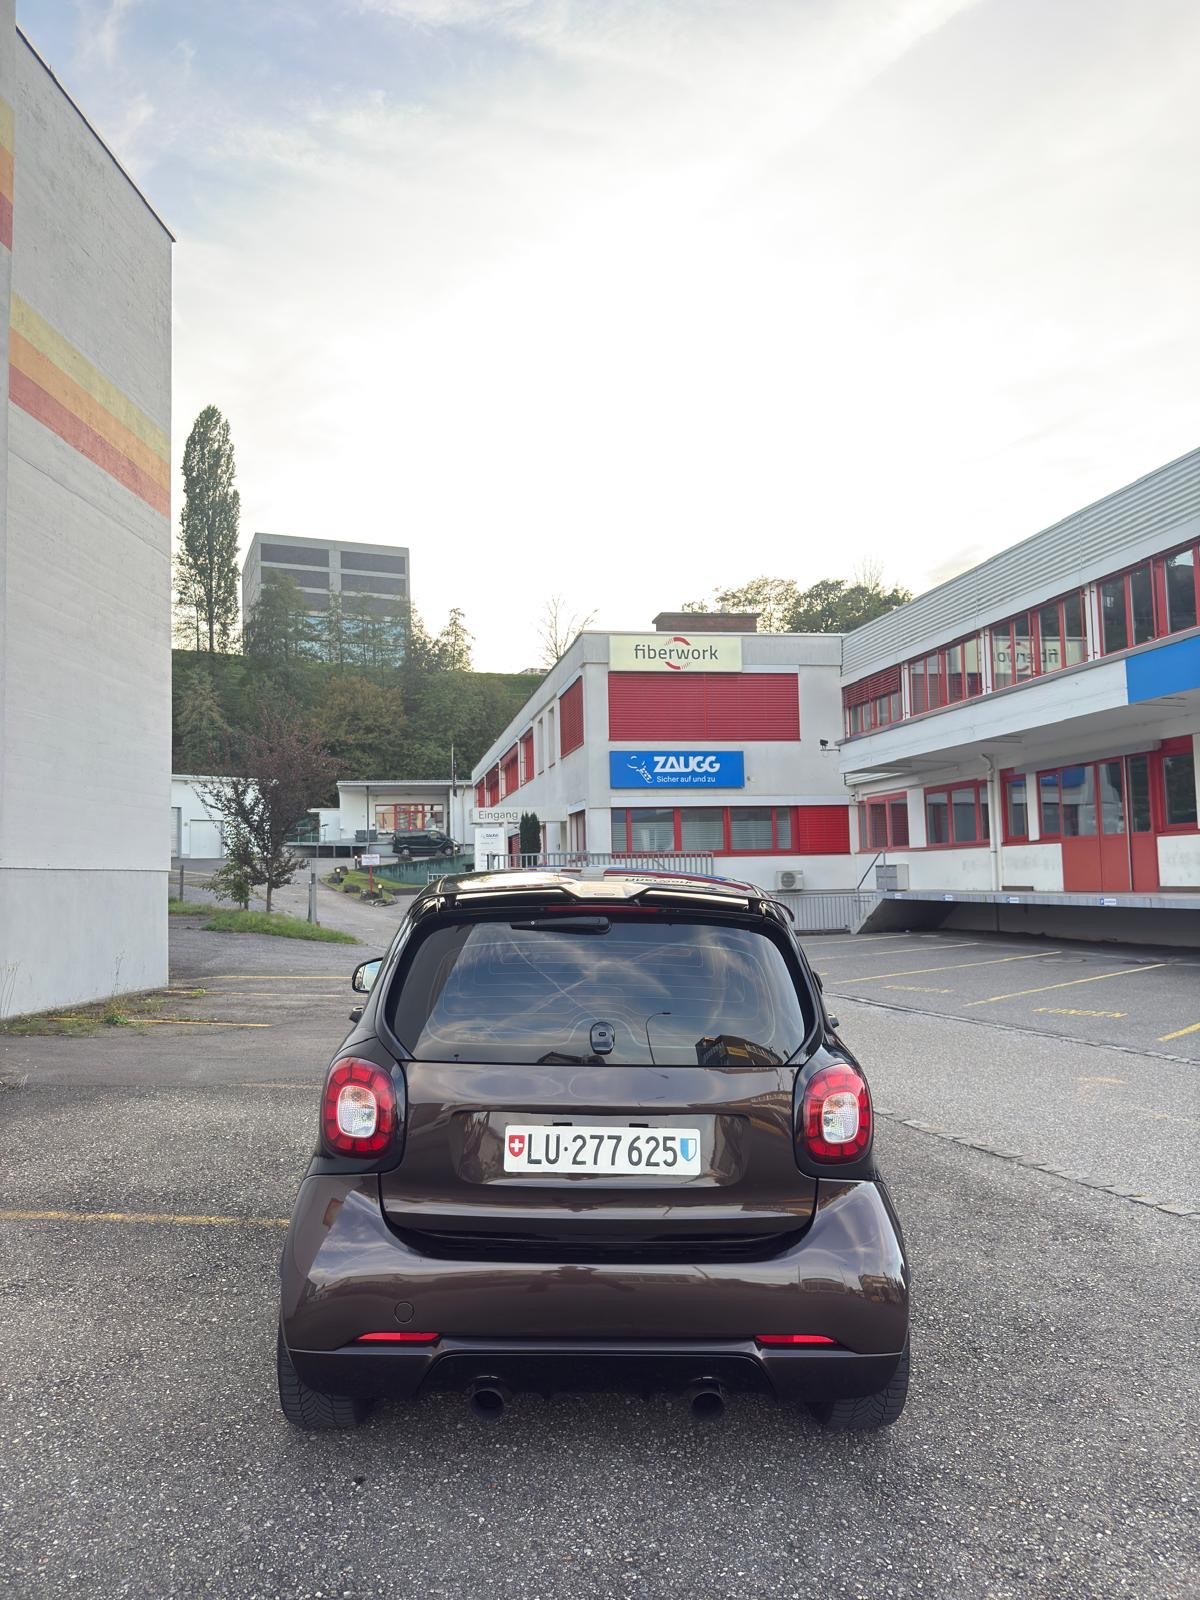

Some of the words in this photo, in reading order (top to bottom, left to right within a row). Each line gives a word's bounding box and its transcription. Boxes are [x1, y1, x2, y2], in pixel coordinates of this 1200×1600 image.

[634, 644, 719, 661] fiberwork
[653, 755, 721, 773] ZAUGG
[656, 775, 679, 783] Sicher
[680, 775, 692, 783] auf
[692, 775, 707, 783] und
[478, 810, 518, 821] Eingang
